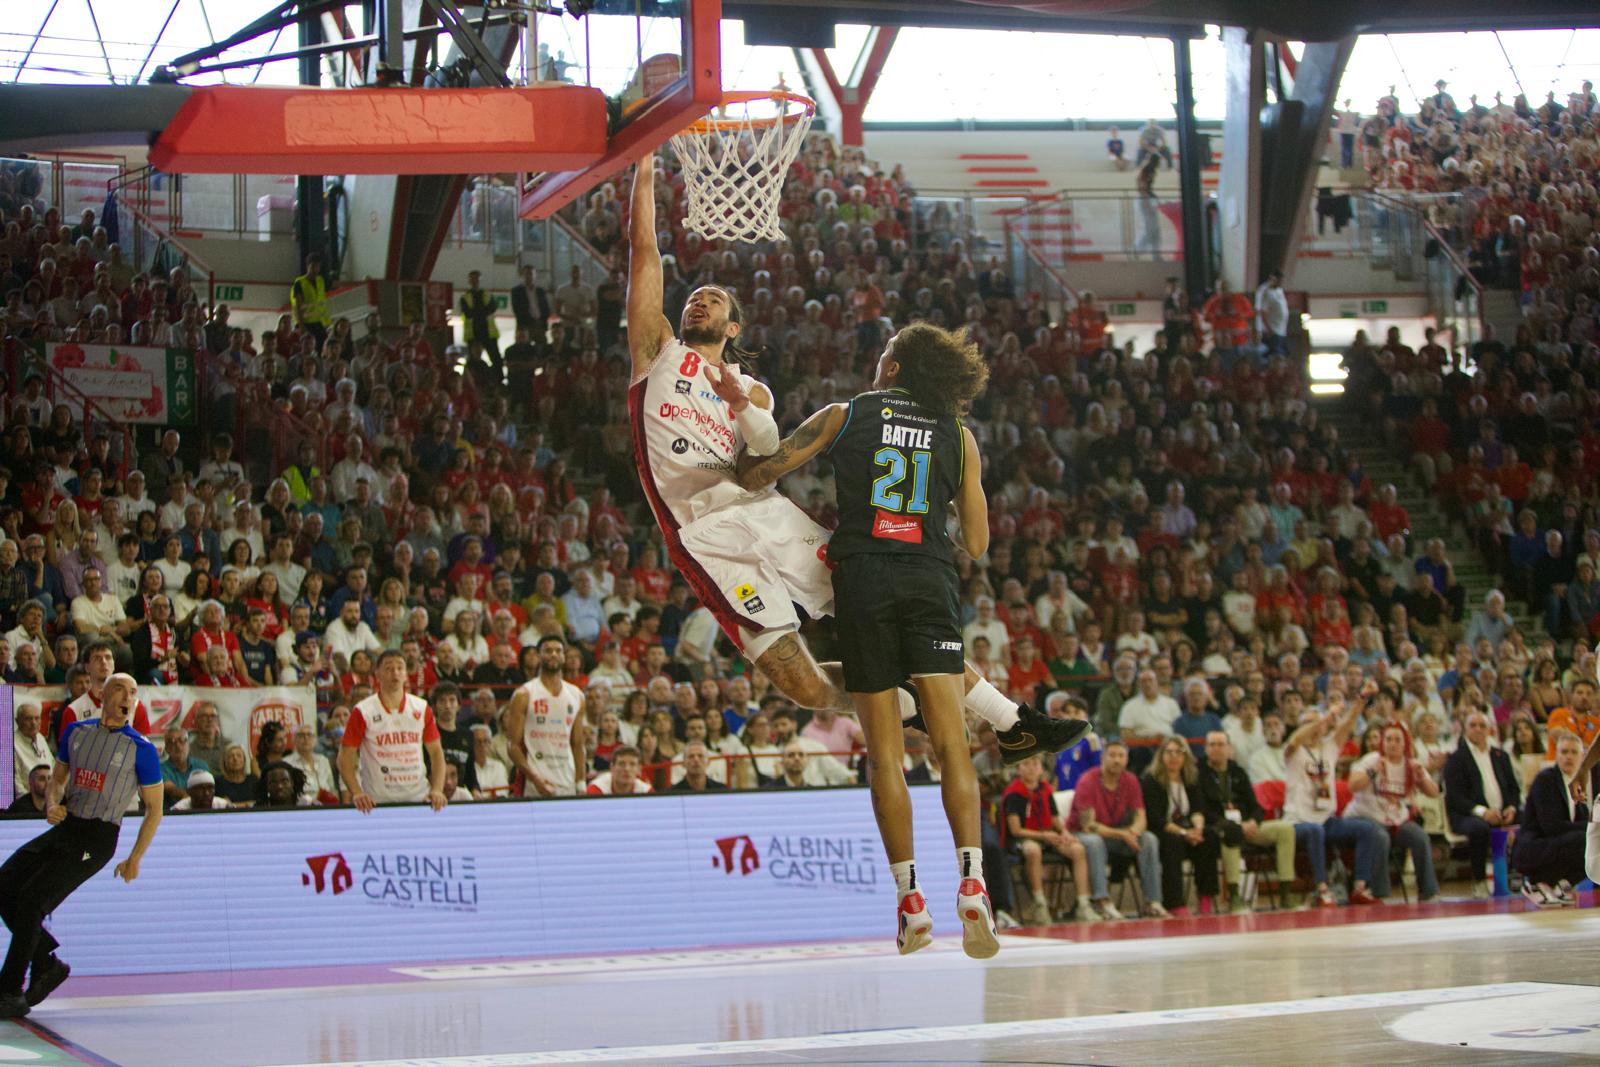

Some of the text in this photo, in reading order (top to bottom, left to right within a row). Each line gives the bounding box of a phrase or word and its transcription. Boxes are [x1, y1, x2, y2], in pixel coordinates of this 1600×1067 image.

[680, 352, 701, 377] 8
[174, 355, 189, 405] BAR
[882, 397, 910, 405] Gruppo
[881, 423, 933, 450] BATTLE
[871, 446, 932, 514] 21
[533, 699, 548, 715] 15
[768, 835, 853, 860] ALBINI
[362, 854, 453, 879] ALBINI
[768, 859, 877, 885] CASTELLI
[362, 877, 478, 905] CASTELLI
